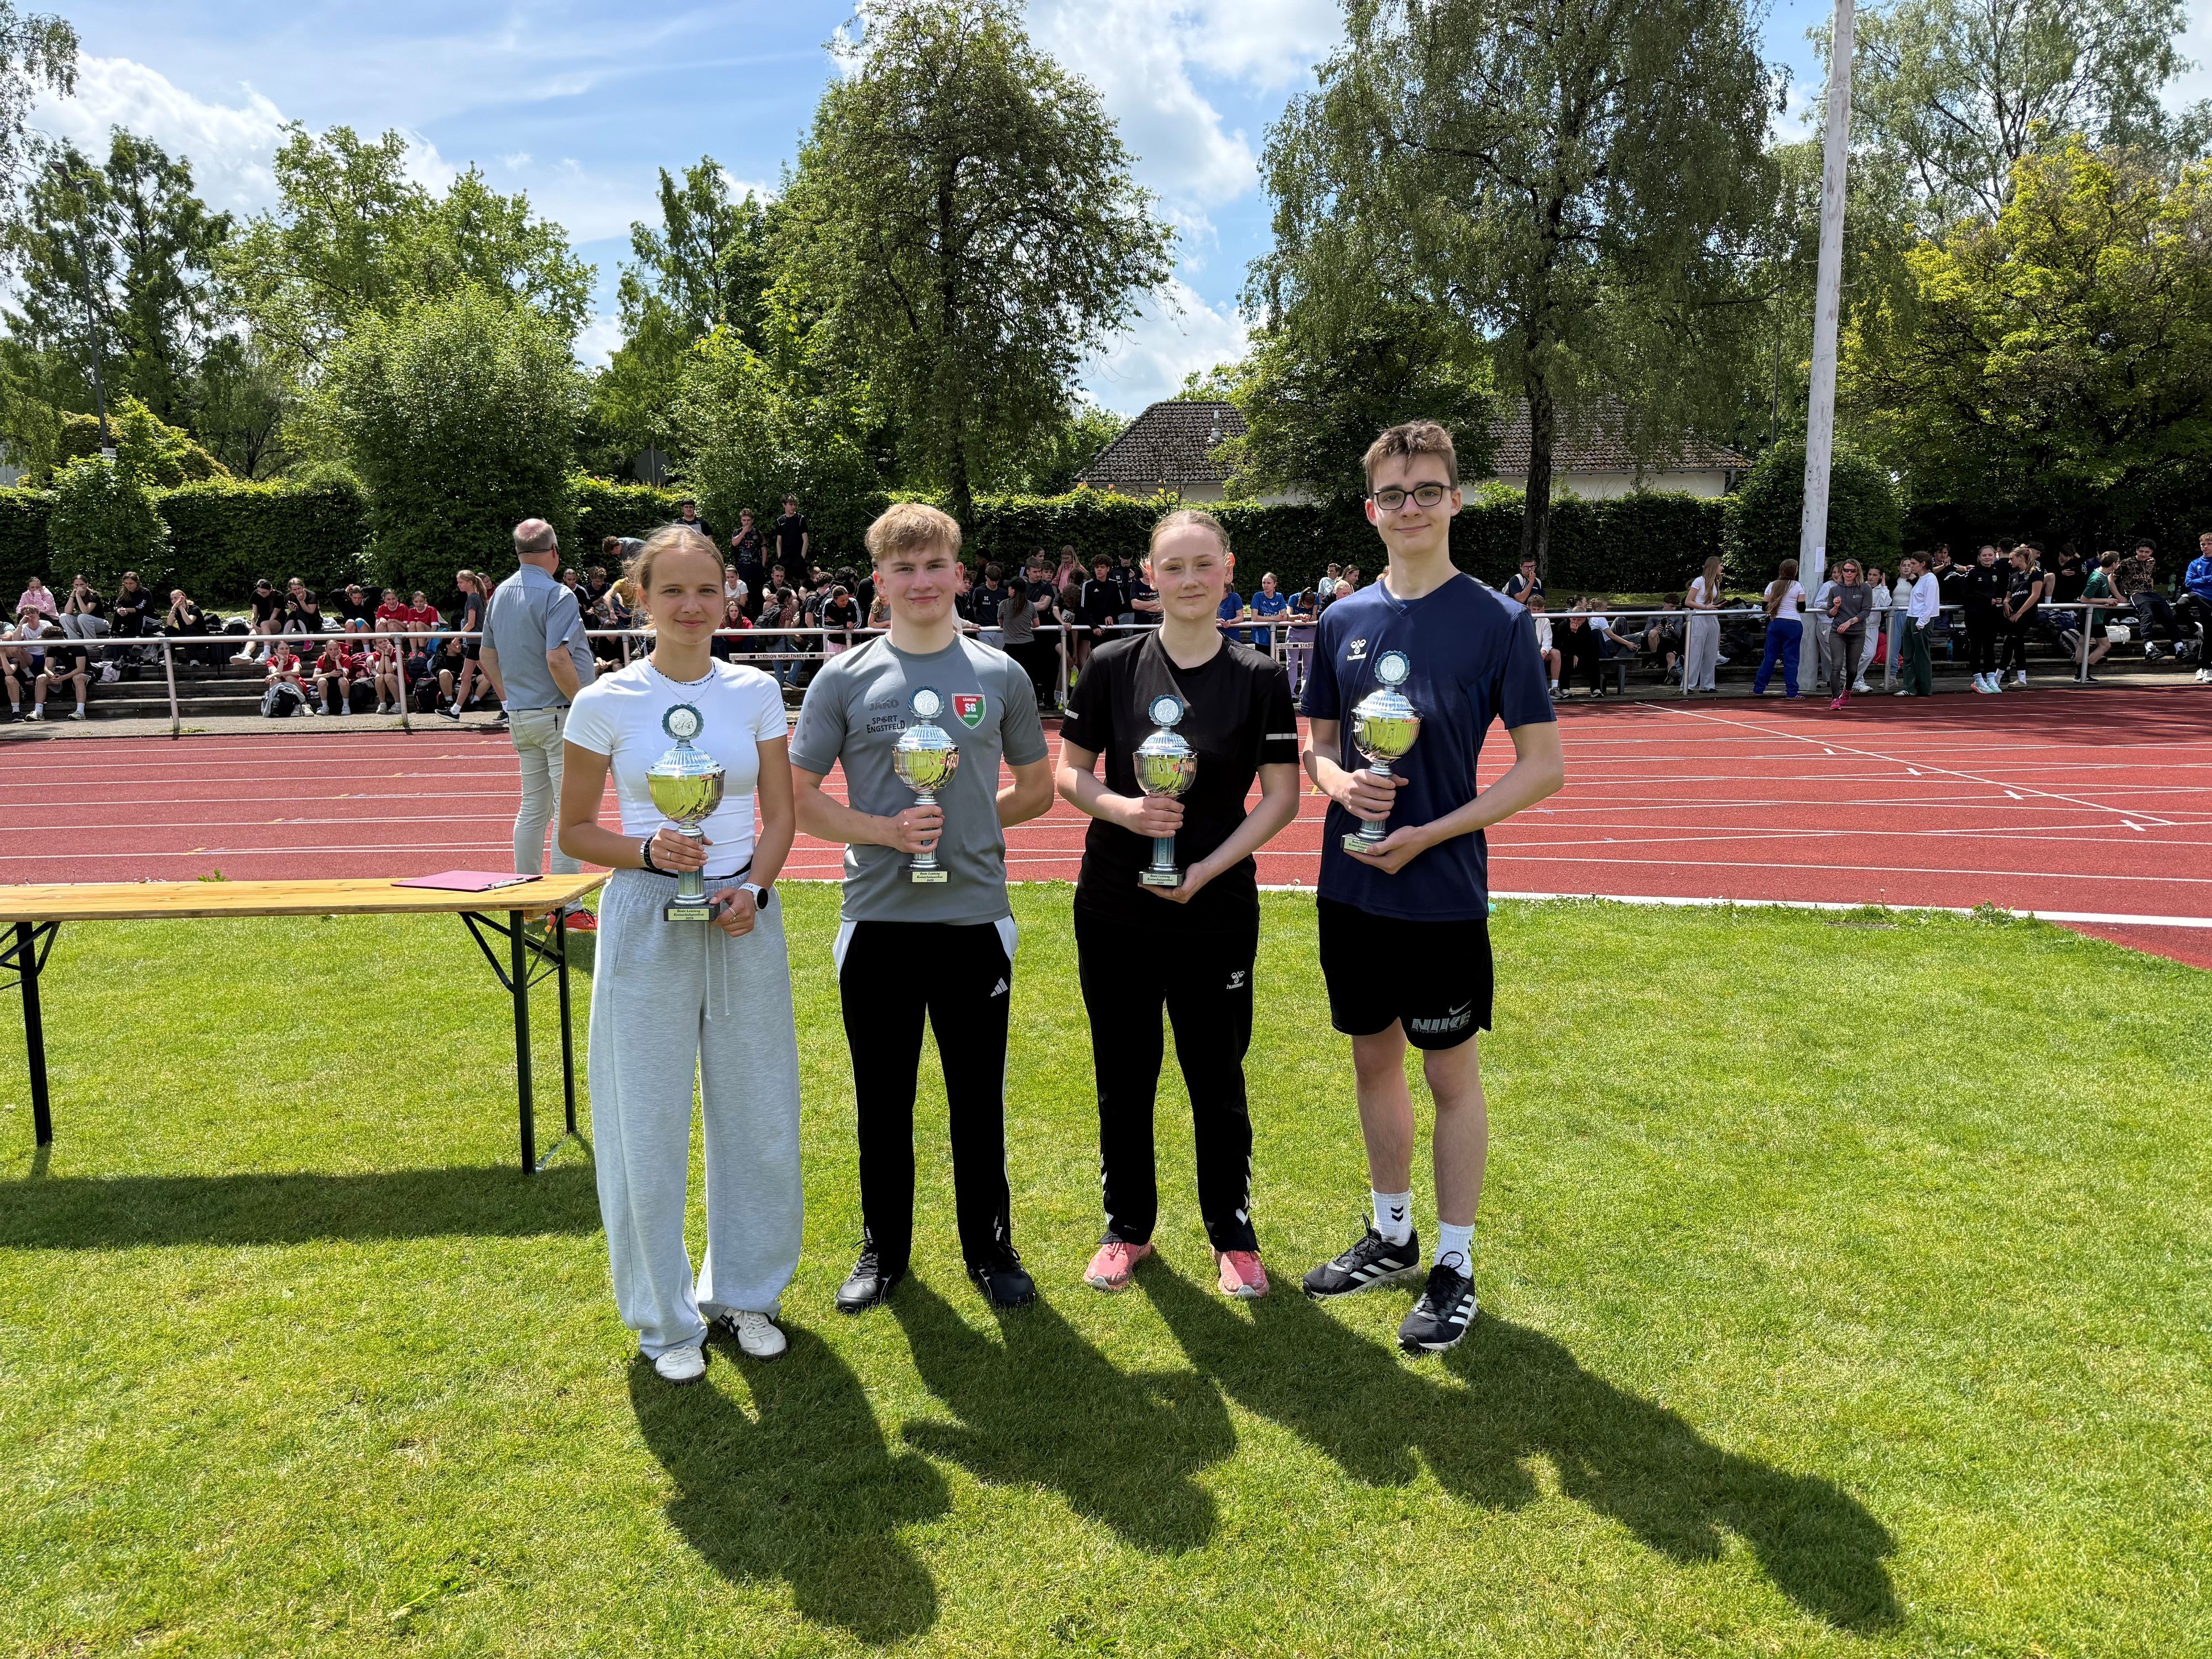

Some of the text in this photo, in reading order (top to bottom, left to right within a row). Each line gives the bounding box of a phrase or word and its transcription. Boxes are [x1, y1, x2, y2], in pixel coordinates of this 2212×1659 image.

[869, 699, 899, 711] JAKO
[964, 703, 977, 712] SG
[872, 714, 898, 724] SPORT
[867, 720, 905, 734] ENGSTFELD
[1226, 981, 1244, 989] hummel
[1411, 1010, 1471, 1034] NIKE
